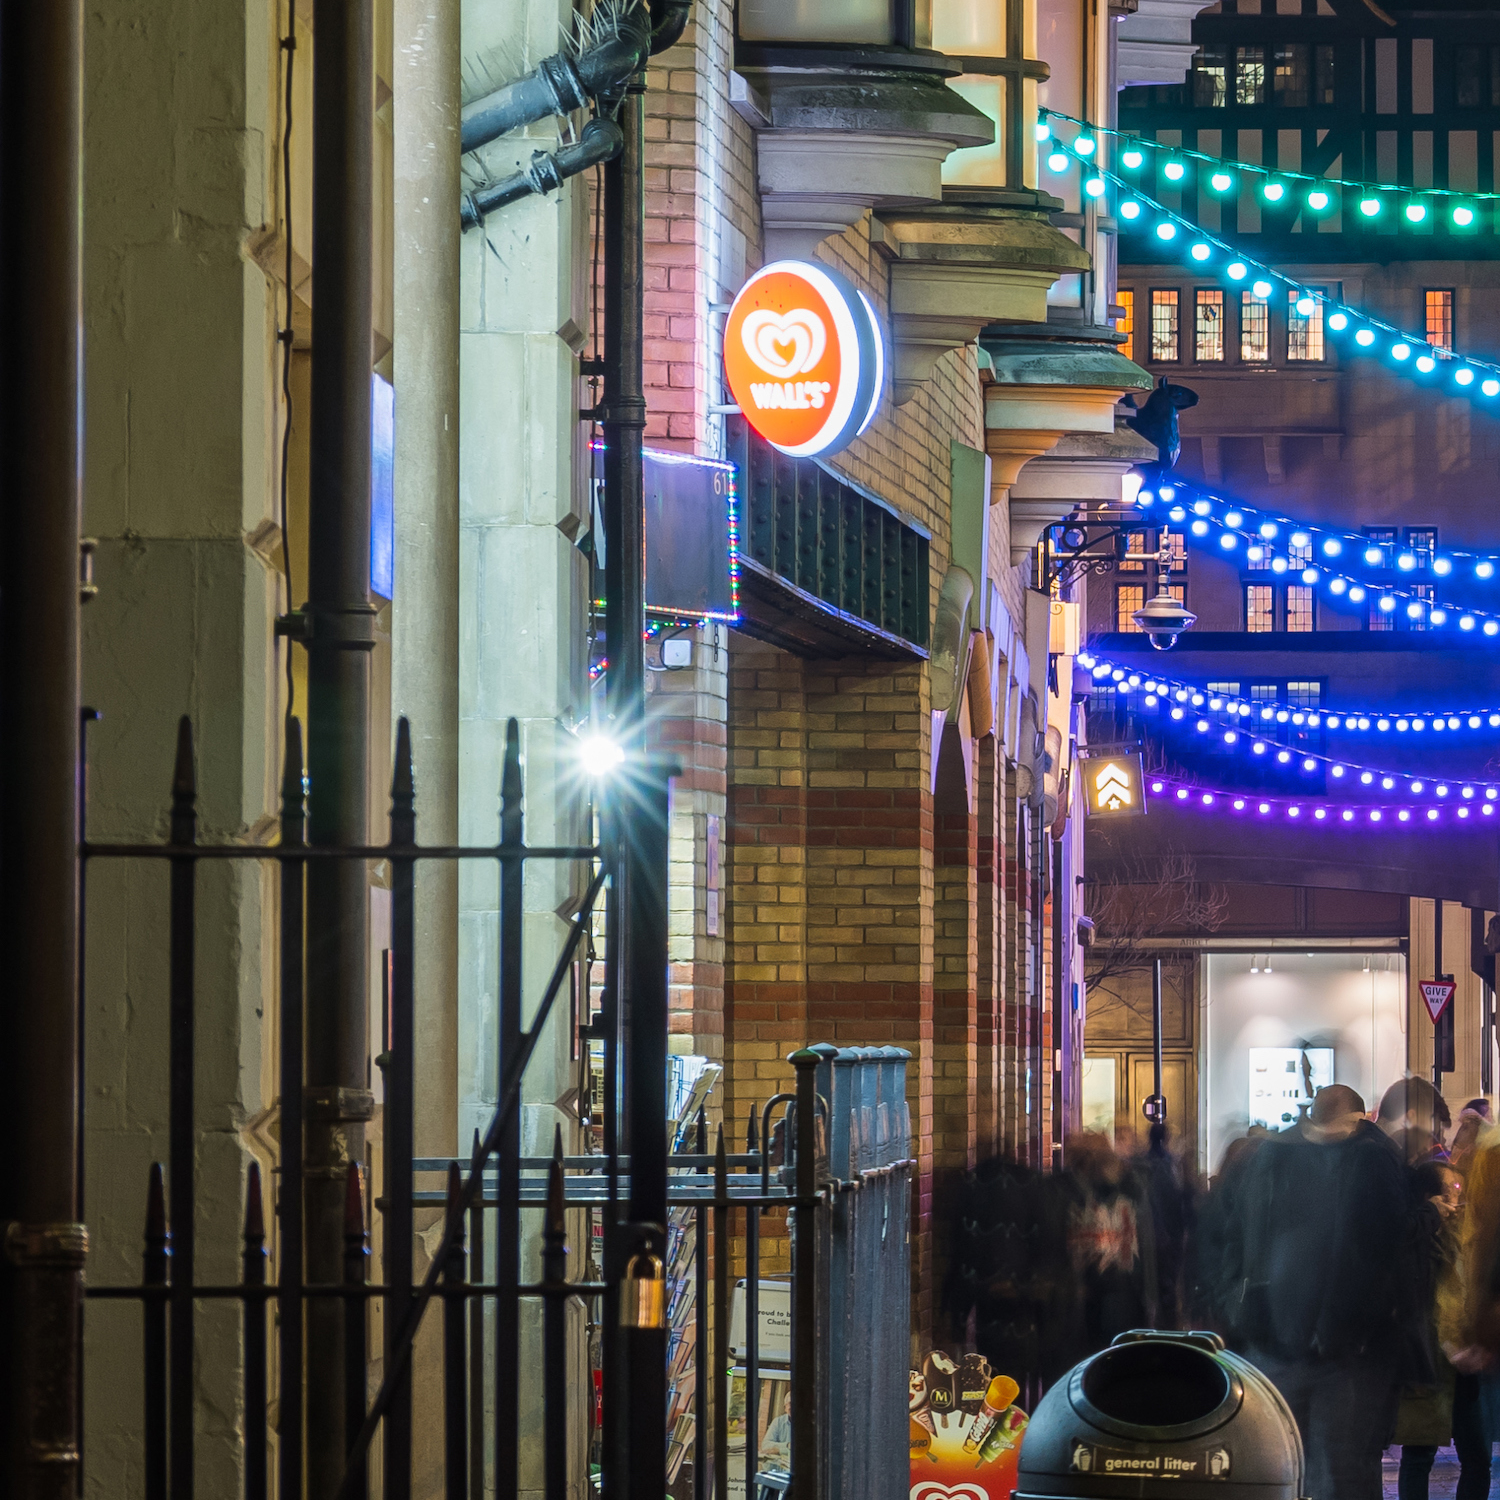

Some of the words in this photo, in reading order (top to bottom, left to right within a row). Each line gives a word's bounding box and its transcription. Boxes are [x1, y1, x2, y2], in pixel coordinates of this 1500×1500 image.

[1425, 986, 1448, 998] GIVE
[1105, 1457, 1160, 1472] general
[1163, 1457, 1198, 1471] litter
